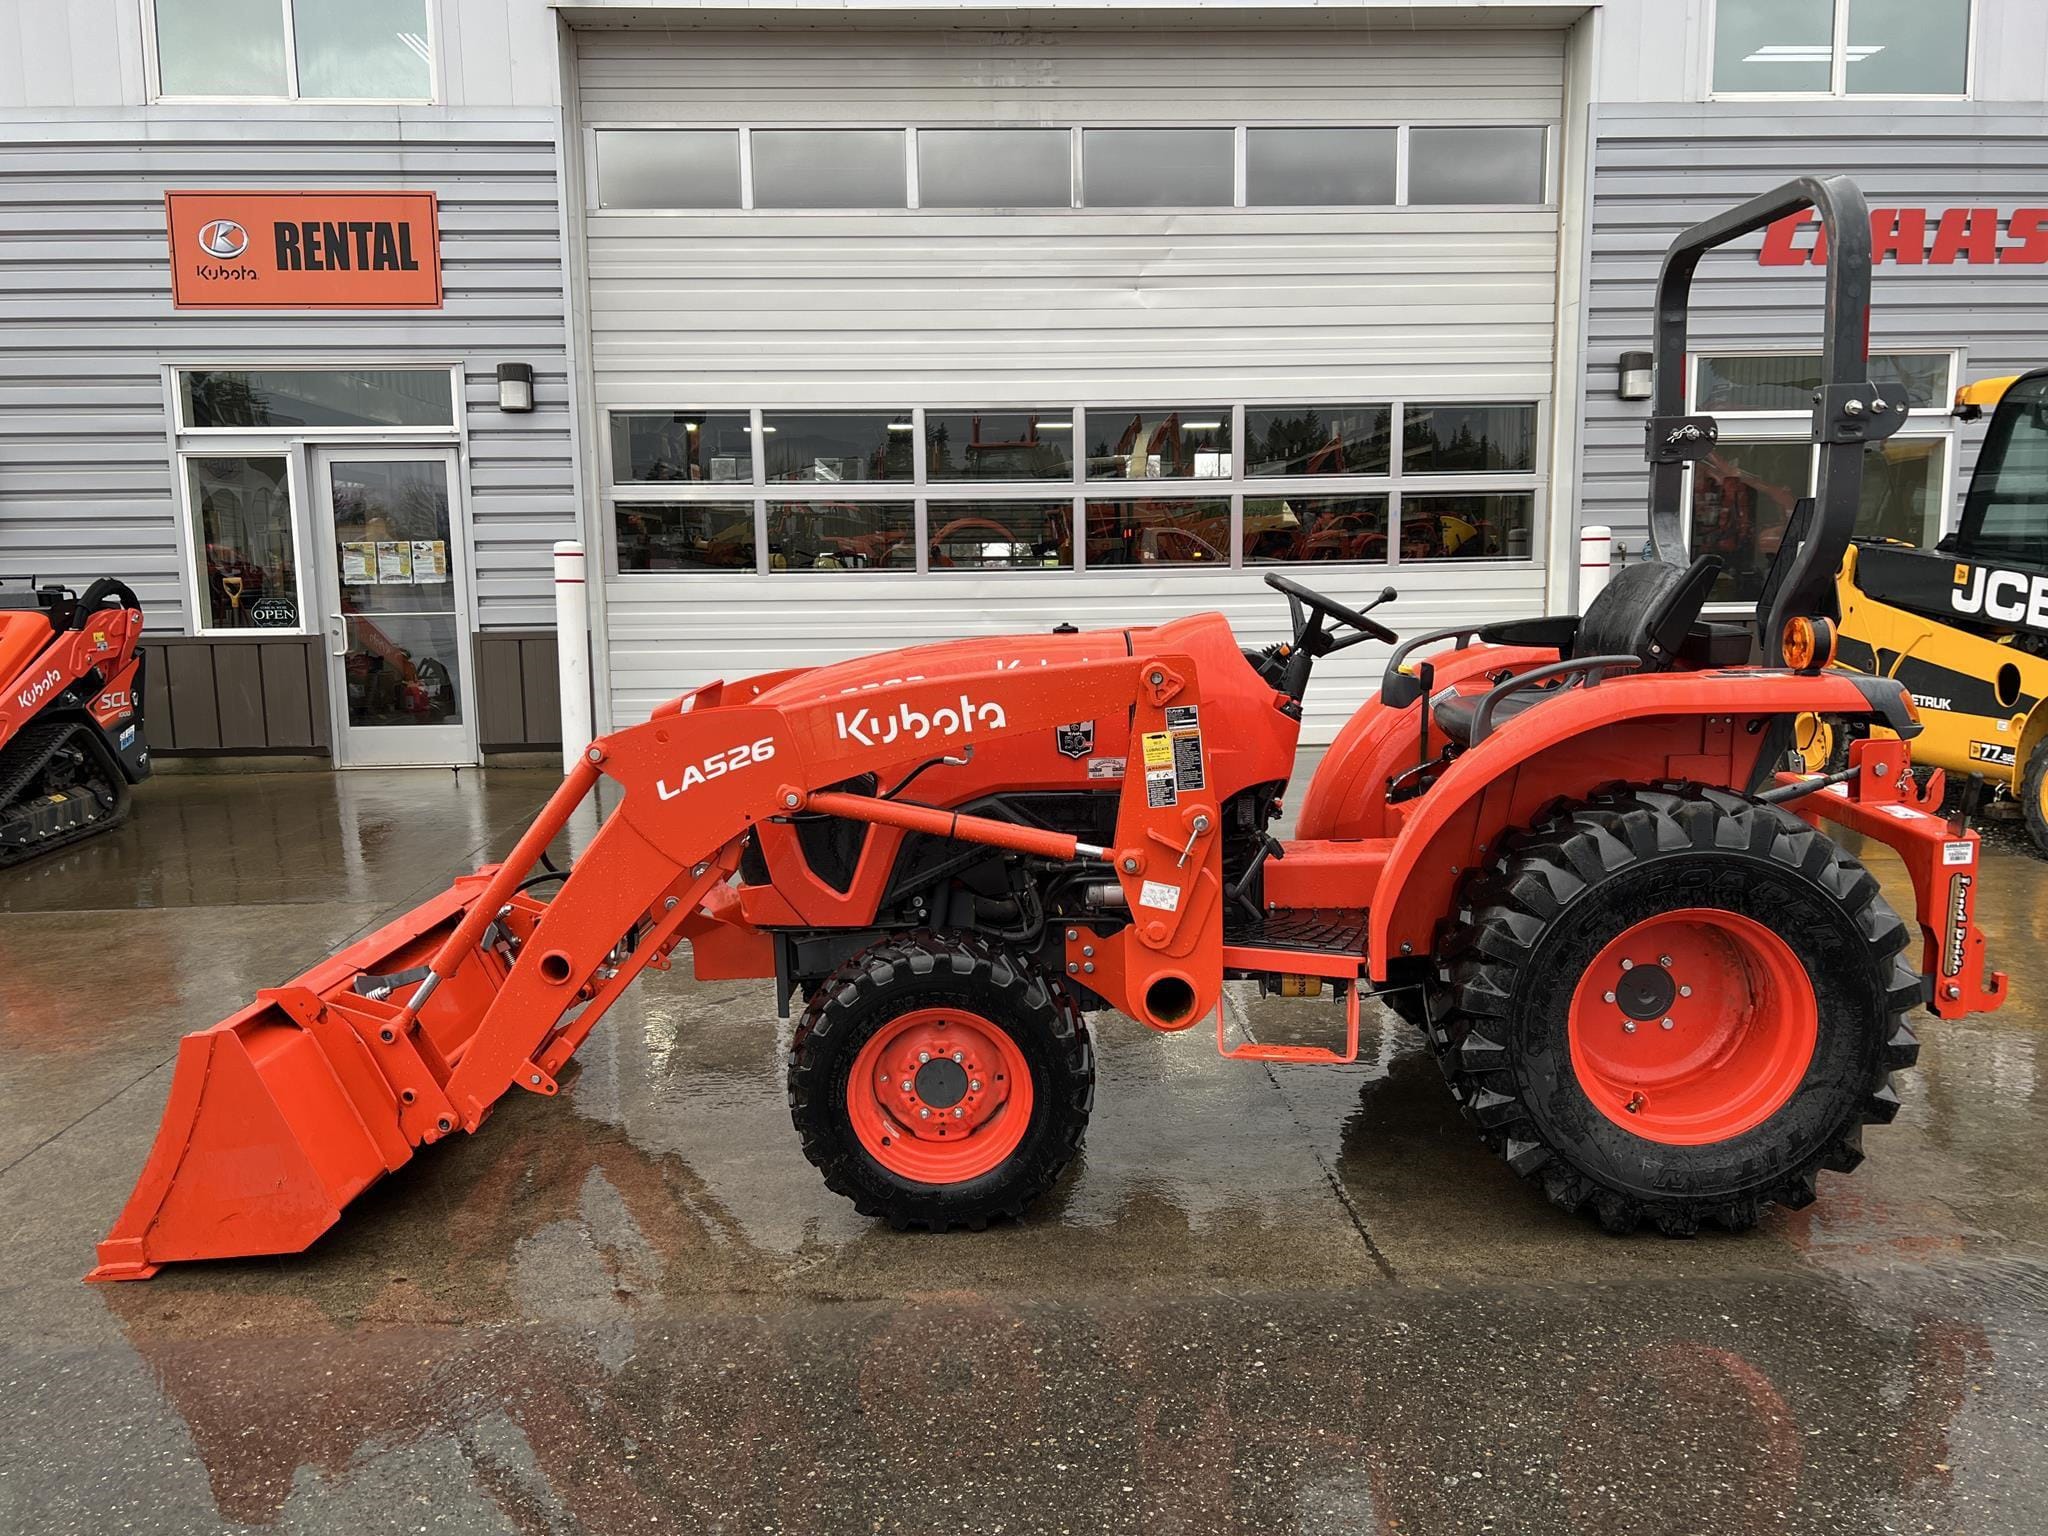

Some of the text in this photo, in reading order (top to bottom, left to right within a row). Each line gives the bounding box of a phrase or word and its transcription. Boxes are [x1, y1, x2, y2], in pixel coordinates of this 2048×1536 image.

[273, 221, 419, 271] RENTAL
[196, 265, 258, 281] Kubota
[253, 609, 295, 620] OPEN
[18, 669, 62, 708] Kubota
[101, 692, 130, 709] SCL
[836, 695, 1006, 746] Kubota
[656, 737, 775, 801] LA526
